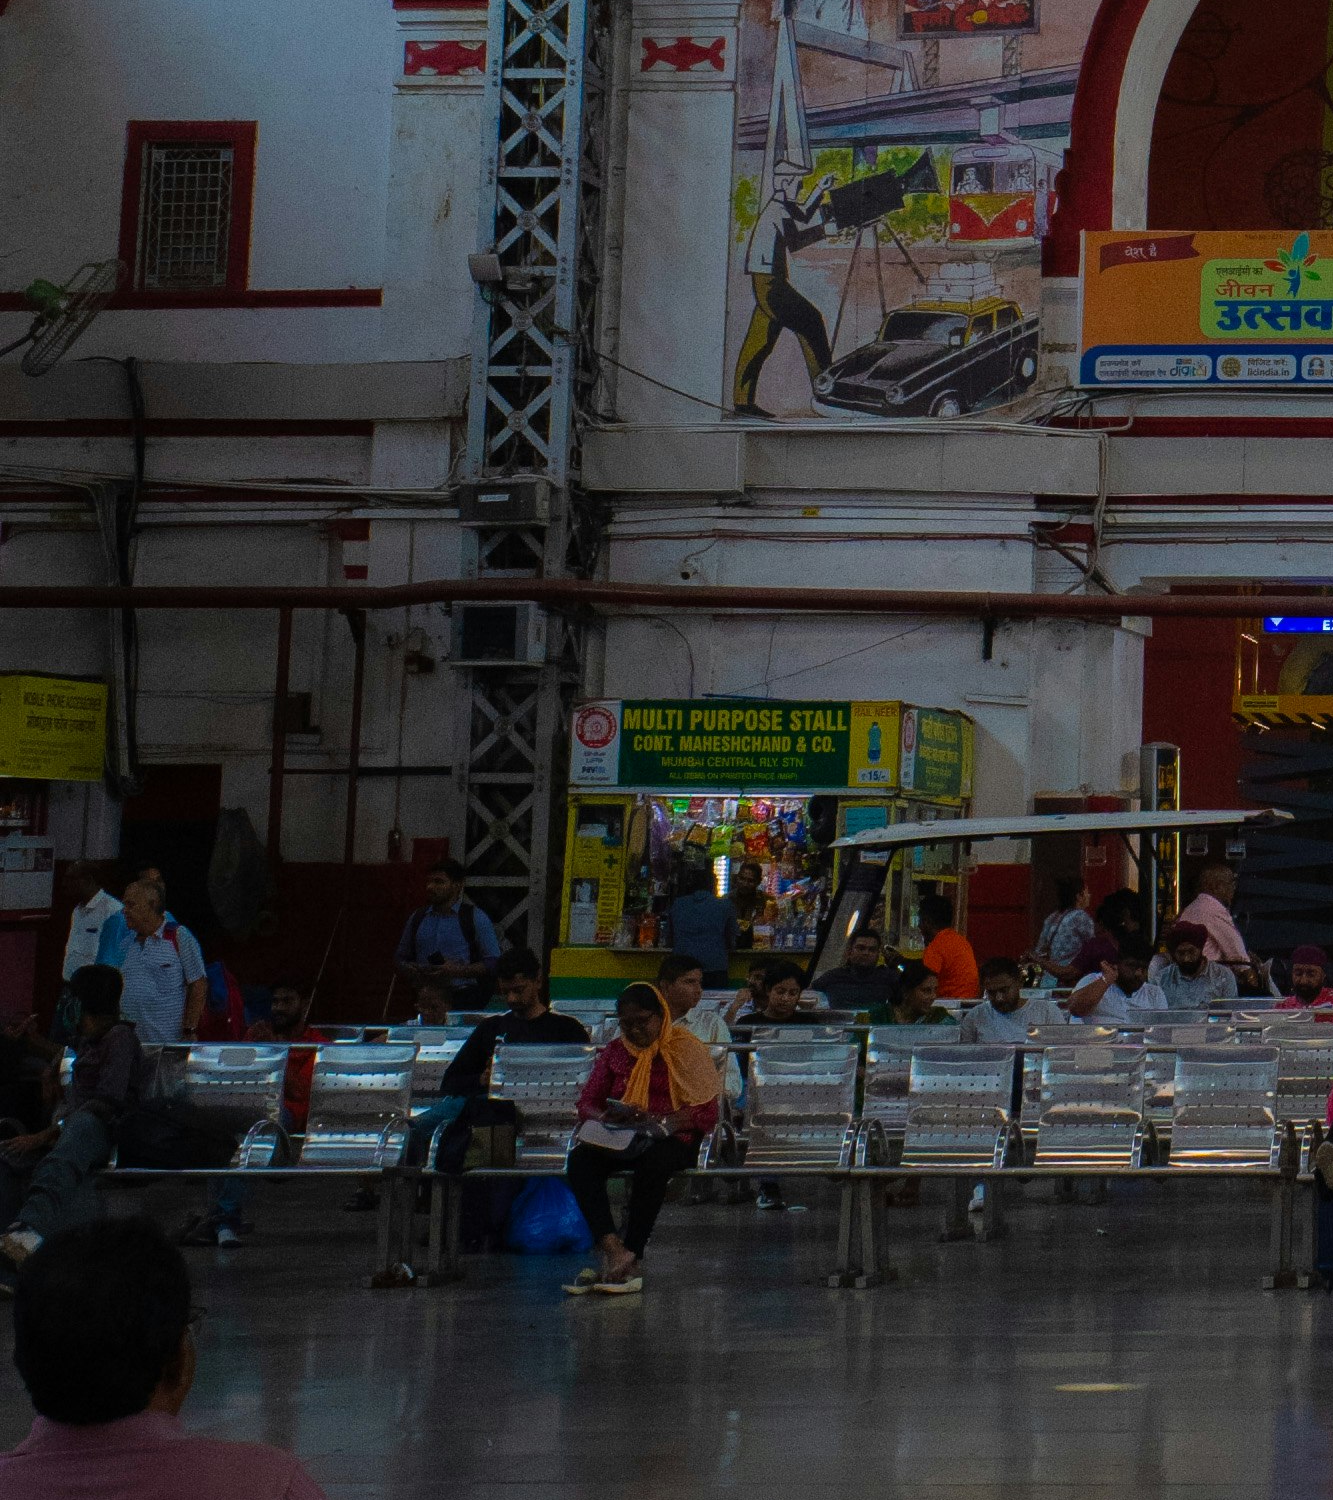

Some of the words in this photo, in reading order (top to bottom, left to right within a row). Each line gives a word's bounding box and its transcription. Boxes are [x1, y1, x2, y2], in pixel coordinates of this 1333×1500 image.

[1215, 279, 1275, 298] जीवन
[623, 708, 683, 731] MULTI
[690, 708, 783, 732] PURPOSE
[789, 708, 849, 732] STALL
[874, 705, 899, 718] NEER
[634, 736, 675, 752] CONT.
[679, 736, 793, 753] MAHESHCHAND
[796, 736, 807, 752] &
[812, 736, 837, 753] CO.
[662, 757, 705, 768] MUMBAI
[707, 757, 755, 768] CENTRAL
